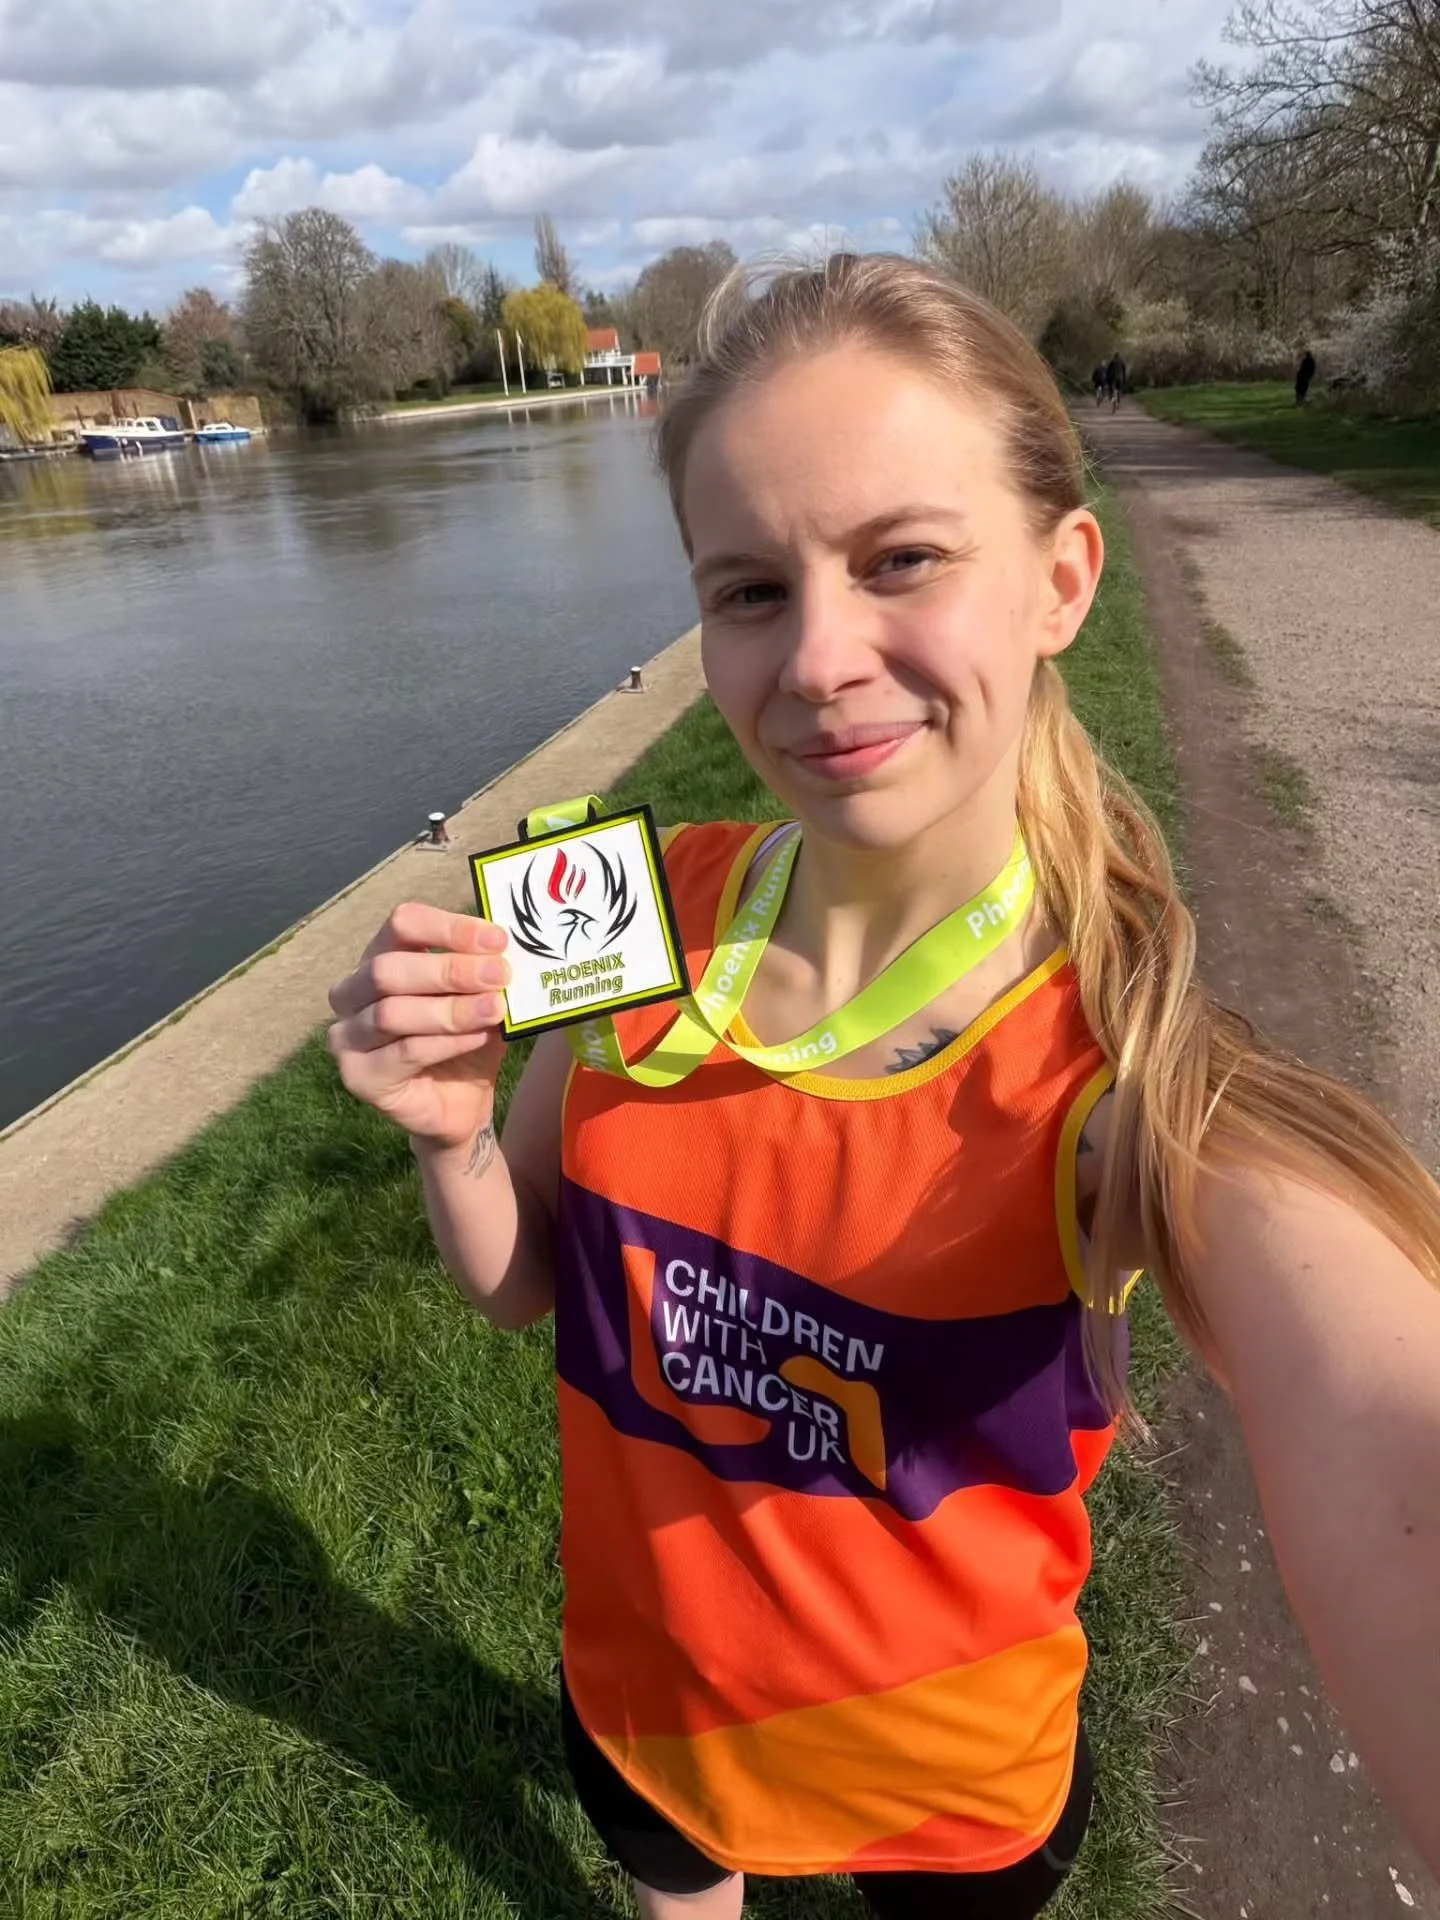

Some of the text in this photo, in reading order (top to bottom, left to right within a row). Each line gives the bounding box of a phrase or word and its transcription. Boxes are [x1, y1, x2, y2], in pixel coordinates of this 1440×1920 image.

[541, 952, 626, 989] PHOENIX
[550, 975, 624, 1007] Running
[663, 1301, 767, 1366] WITH
[665, 1259, 885, 1373] CHILDREN
[662, 1352, 839, 1439] CANCER
[788, 1421, 846, 1465] UK
